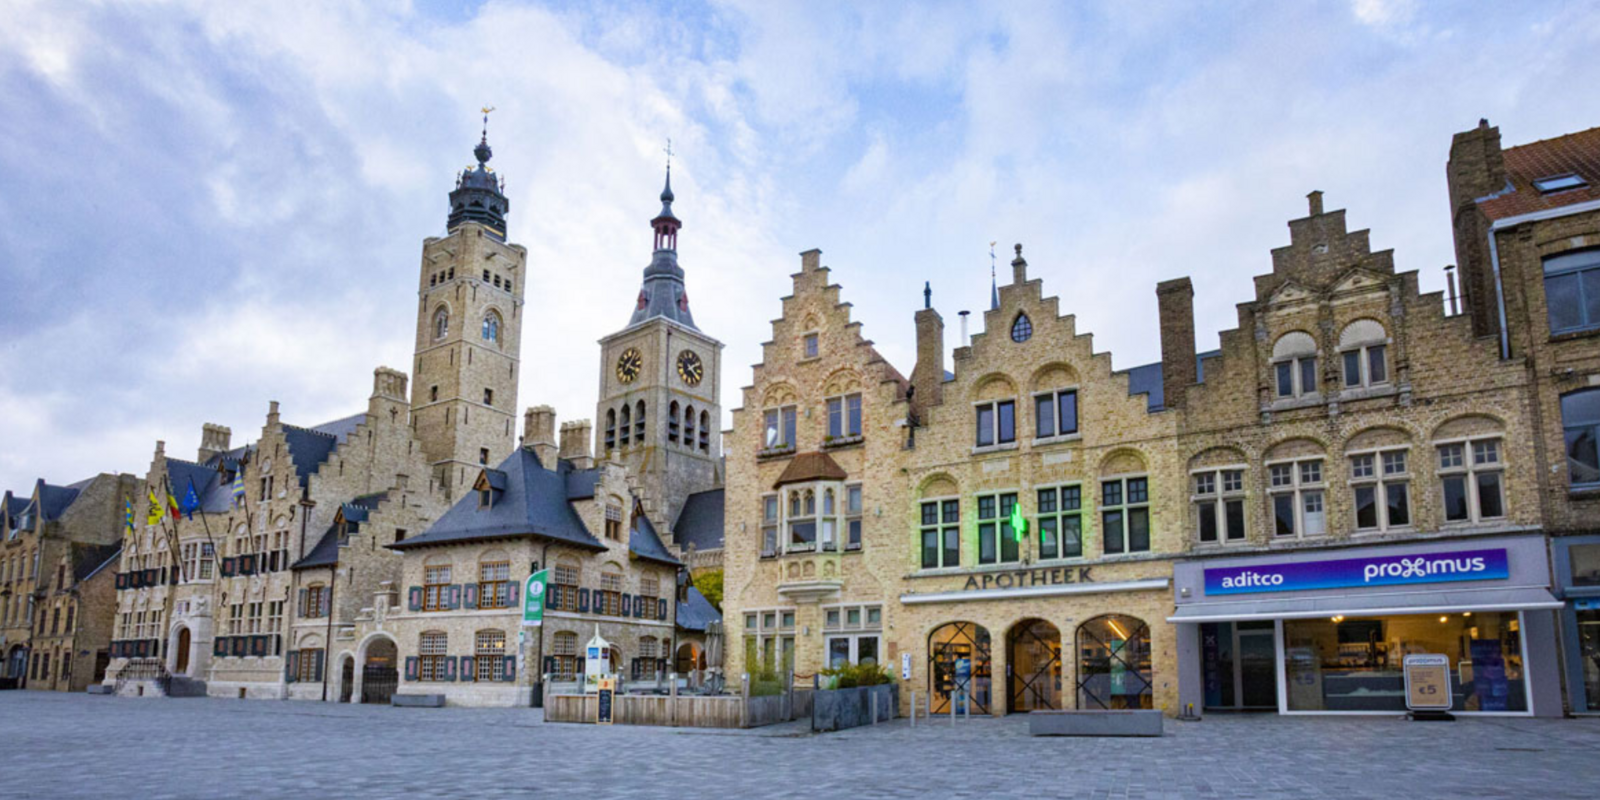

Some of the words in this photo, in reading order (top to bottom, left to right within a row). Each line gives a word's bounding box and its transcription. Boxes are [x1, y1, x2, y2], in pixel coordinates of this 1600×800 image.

[964, 567, 1094, 591] APOTHEEK
[1221, 571, 1284, 588] aditco
[1419, 685, 1437, 695] €5
